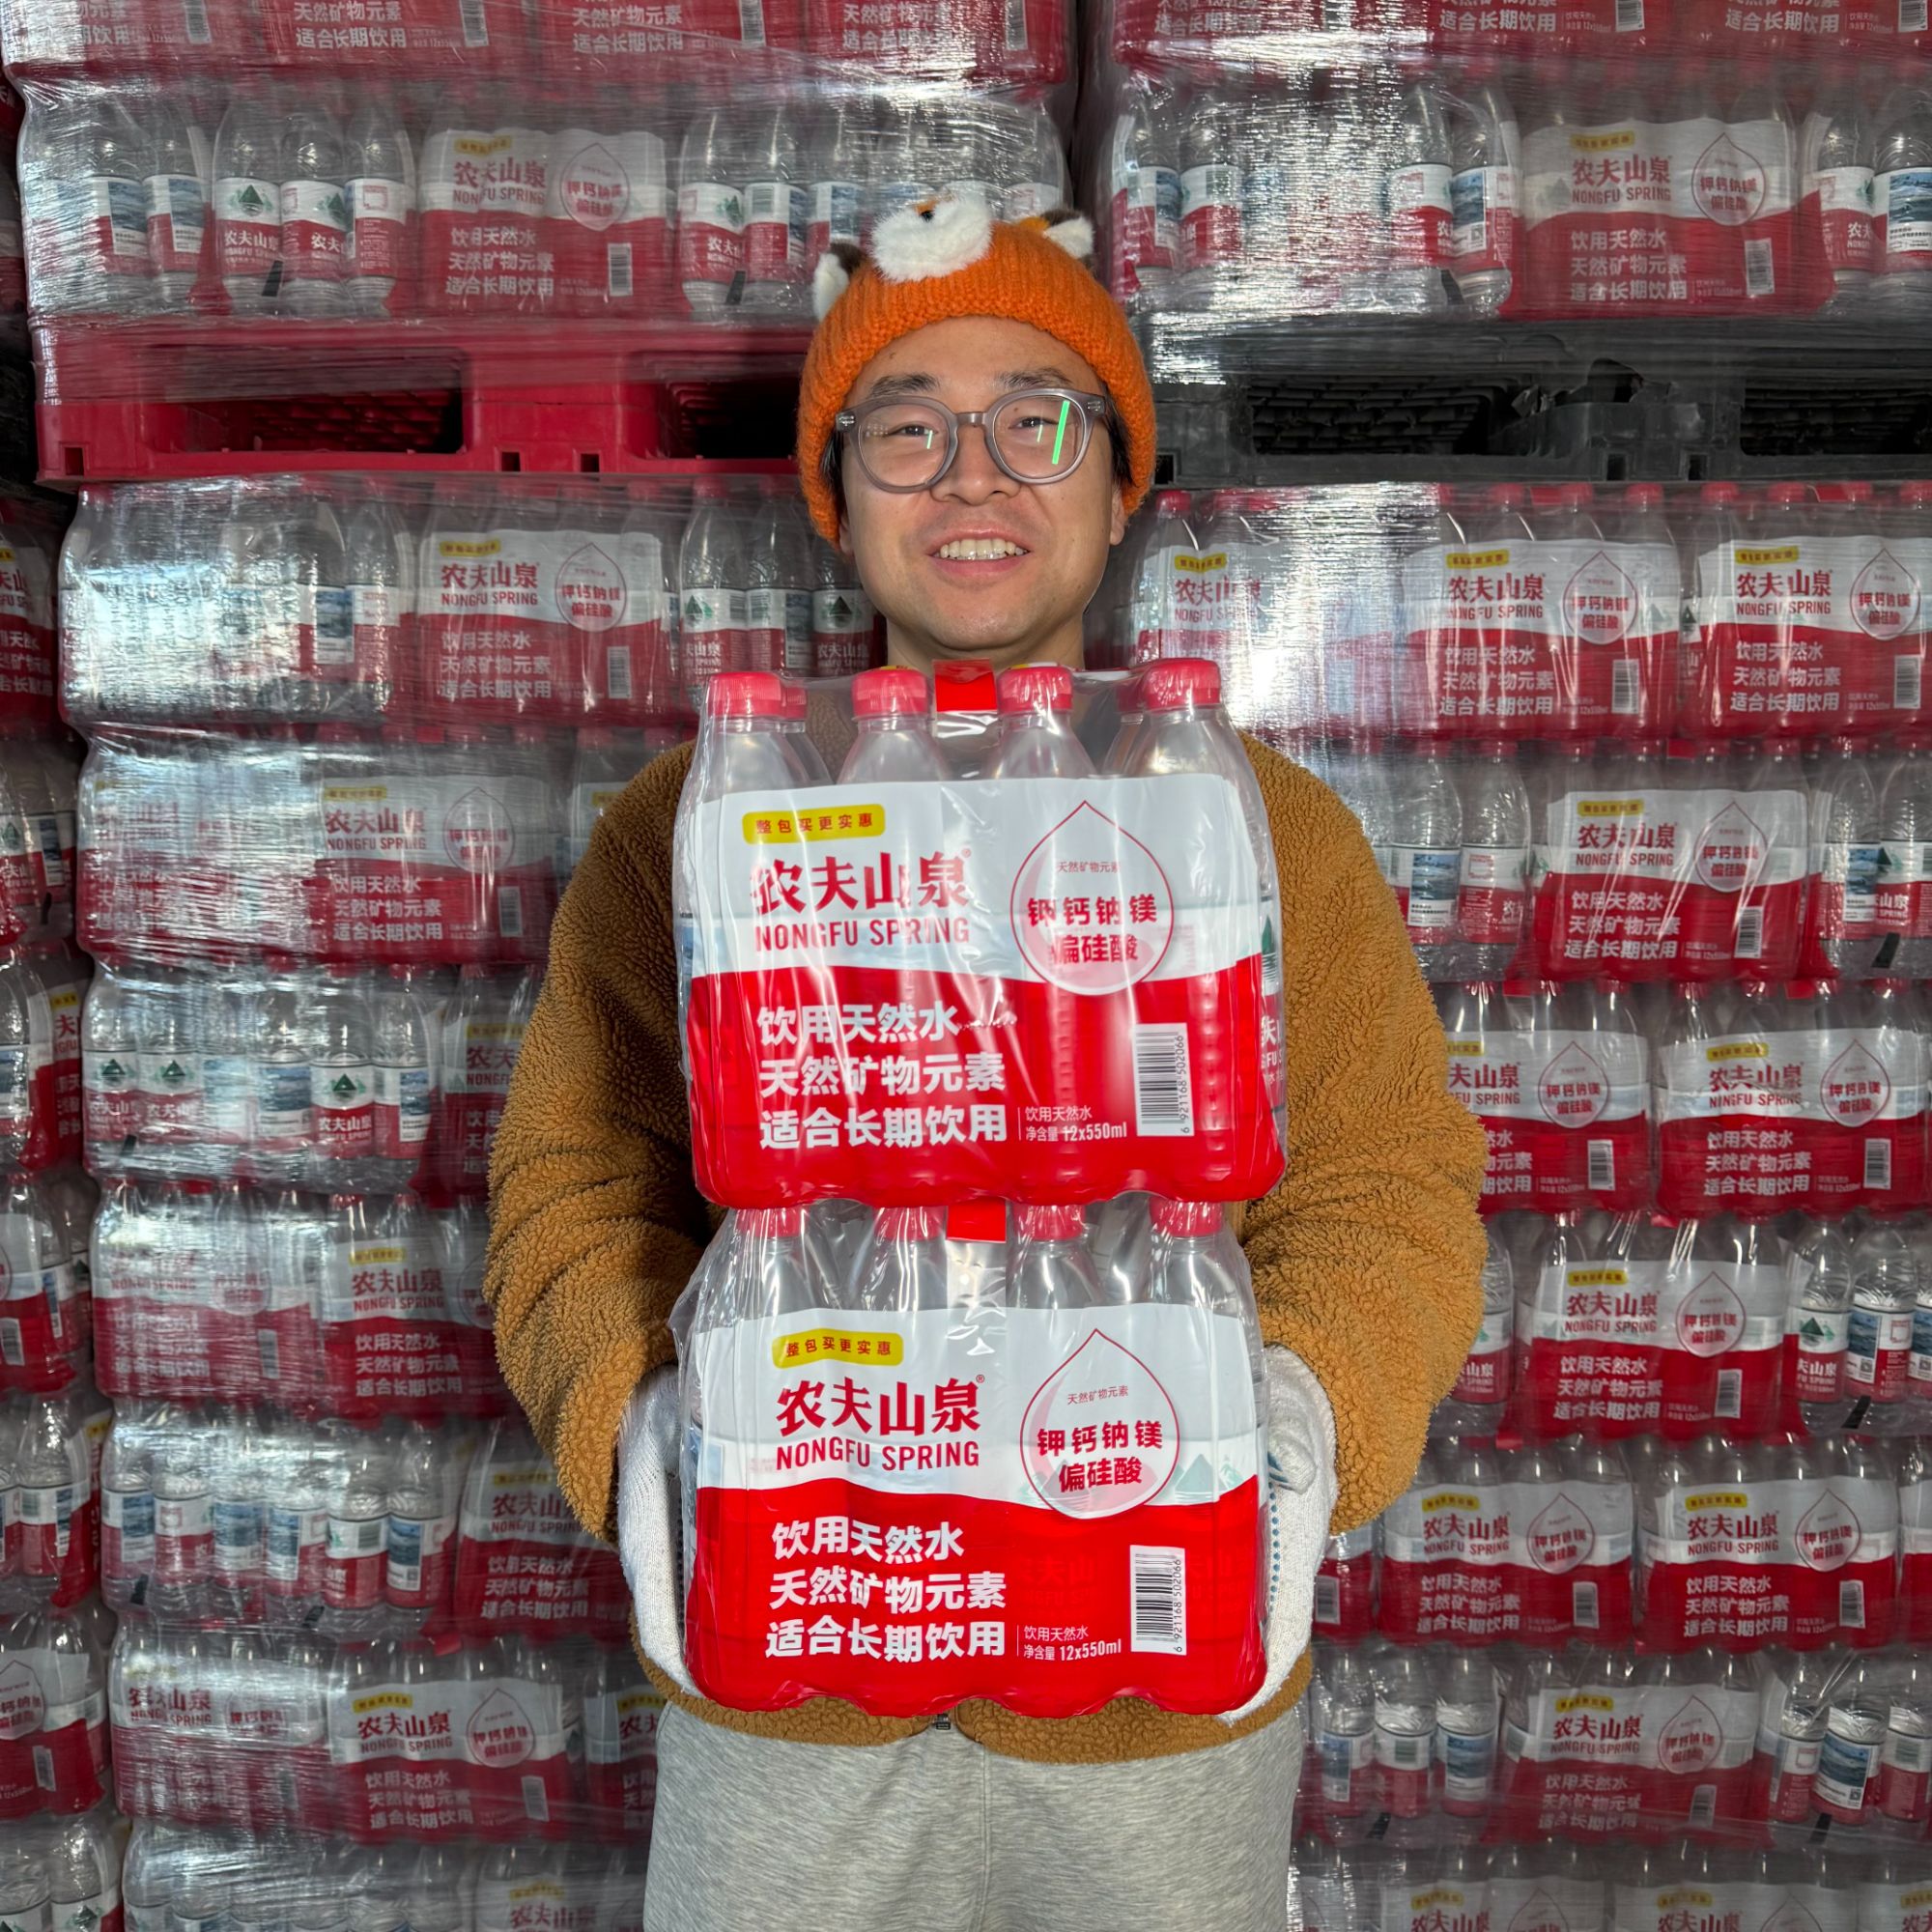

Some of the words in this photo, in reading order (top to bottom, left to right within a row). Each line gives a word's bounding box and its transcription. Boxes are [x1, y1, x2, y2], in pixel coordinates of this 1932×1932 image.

[1725, 9, 1839, 34] 适合长期饮用
[296, 27, 407, 49] 适合长期饮用
[1573, 156, 1670, 185] 农夫山泉
[1627, 187, 1671, 202] SPRING
[1572, 229, 1665, 252] 饮用天然水
[1571, 280, 1687, 300] 适合长期饮用
[441, 561, 537, 589] 农夫山泉
[1737, 570, 1832, 597] 农夫山泉
[756, 812, 872, 835] 整包买更实惠
[1577, 823, 1675, 849] 农夫山泉
[1059, 861, 1120, 874] 天然矿物元素
[1630, 853, 1673, 867] SPRING
[750, 851, 969, 915] 农夫山泉
[1027, 894, 1157, 927] 钾钙钠镁
[1572, 891, 1663, 911] 饮用天然水
[756, 920, 858, 952] NONGFU
[870, 917, 970, 946] SPRING
[1564, 940, 1677, 959] 适合长期饮用
[756, 1000, 959, 1046] 饮用天然水
[759, 1052, 1006, 1098] 天然矿物元素
[1476, 1093, 1520, 1105] SPRING
[1025, 1106, 1093, 1122] 饮用天然水
[759, 1104, 1008, 1150] 适合长期饮用
[1025, 1126, 1059, 1142] 净含量
[1063, 1122, 1127, 1142] 12x550ml
[1567, 1292, 1658, 1317] 农夫山泉
[1615, 1321, 1657, 1333] SPRING
[786, 1336, 891, 1357] 整包买更实惠
[1561, 1356, 1646, 1376] 饮用天然水
[1067, 1385, 1128, 1405] 天然矿物元素
[776, 1377, 980, 1437] 农夫山泉
[1553, 1402, 1660, 1421] 适合长期饮用
[1037, 1420, 1163, 1457] 钾钙钠镁
[776, 1436, 870, 1470] NONGFU
[882, 1441, 980, 1471] SPRING
[1059, 1457, 1142, 1492] 偏硅酸
[1688, 1513, 1777, 1539] 农夫山泉
[772, 1516, 964, 1565] 饮用天然水
[1738, 1540, 1778, 1553] SPRING
[769, 1565, 1006, 1614] 天然矿物元素
[1687, 1575, 1771, 1595] 饮用天然水
[765, 1615, 1006, 1662] 适合长期饮用
[1024, 1625, 1089, 1641] 饮用天然水
[1684, 1617, 1787, 1637] 适合长期饮用
[1024, 1645, 1055, 1662] 净含量
[1060, 1639, 1122, 1662] 12x550ml
